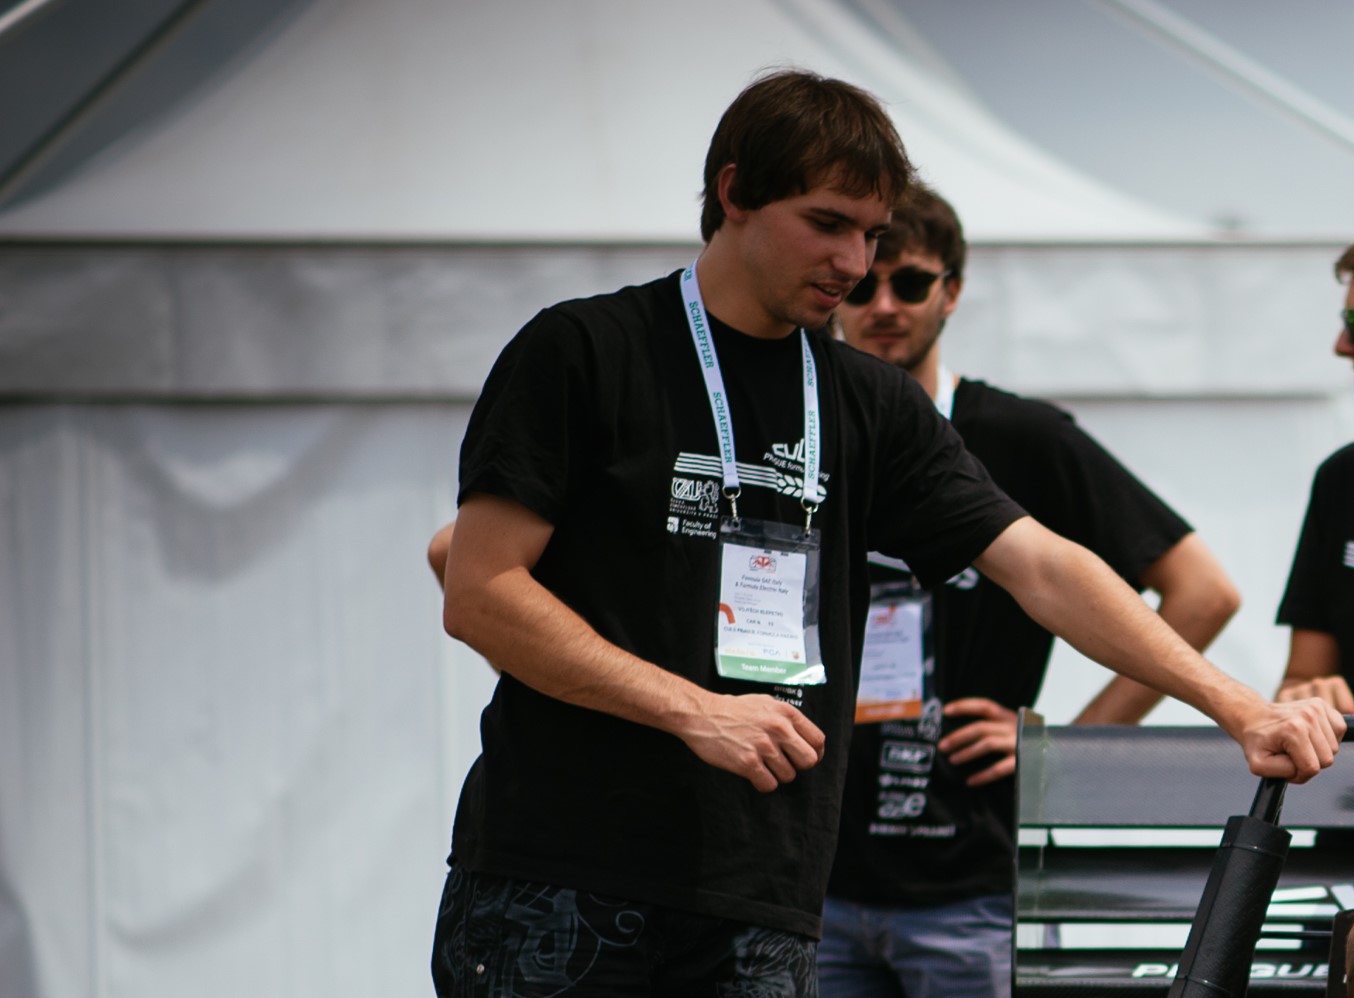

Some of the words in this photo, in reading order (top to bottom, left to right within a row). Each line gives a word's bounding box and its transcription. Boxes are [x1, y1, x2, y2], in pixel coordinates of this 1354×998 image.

[689, 300, 714, 369] SCHAEFFLER
[713, 391, 733, 464] SCHAEFFLER
[808, 409, 817, 480] SCHAEFFLER
[681, 526, 718, 540] Engineering
[682, 519, 704, 530] Faculty
[704, 522, 713, 530] of
[741, 662, 760, 672] Team
[760, 664, 787, 675] Member
